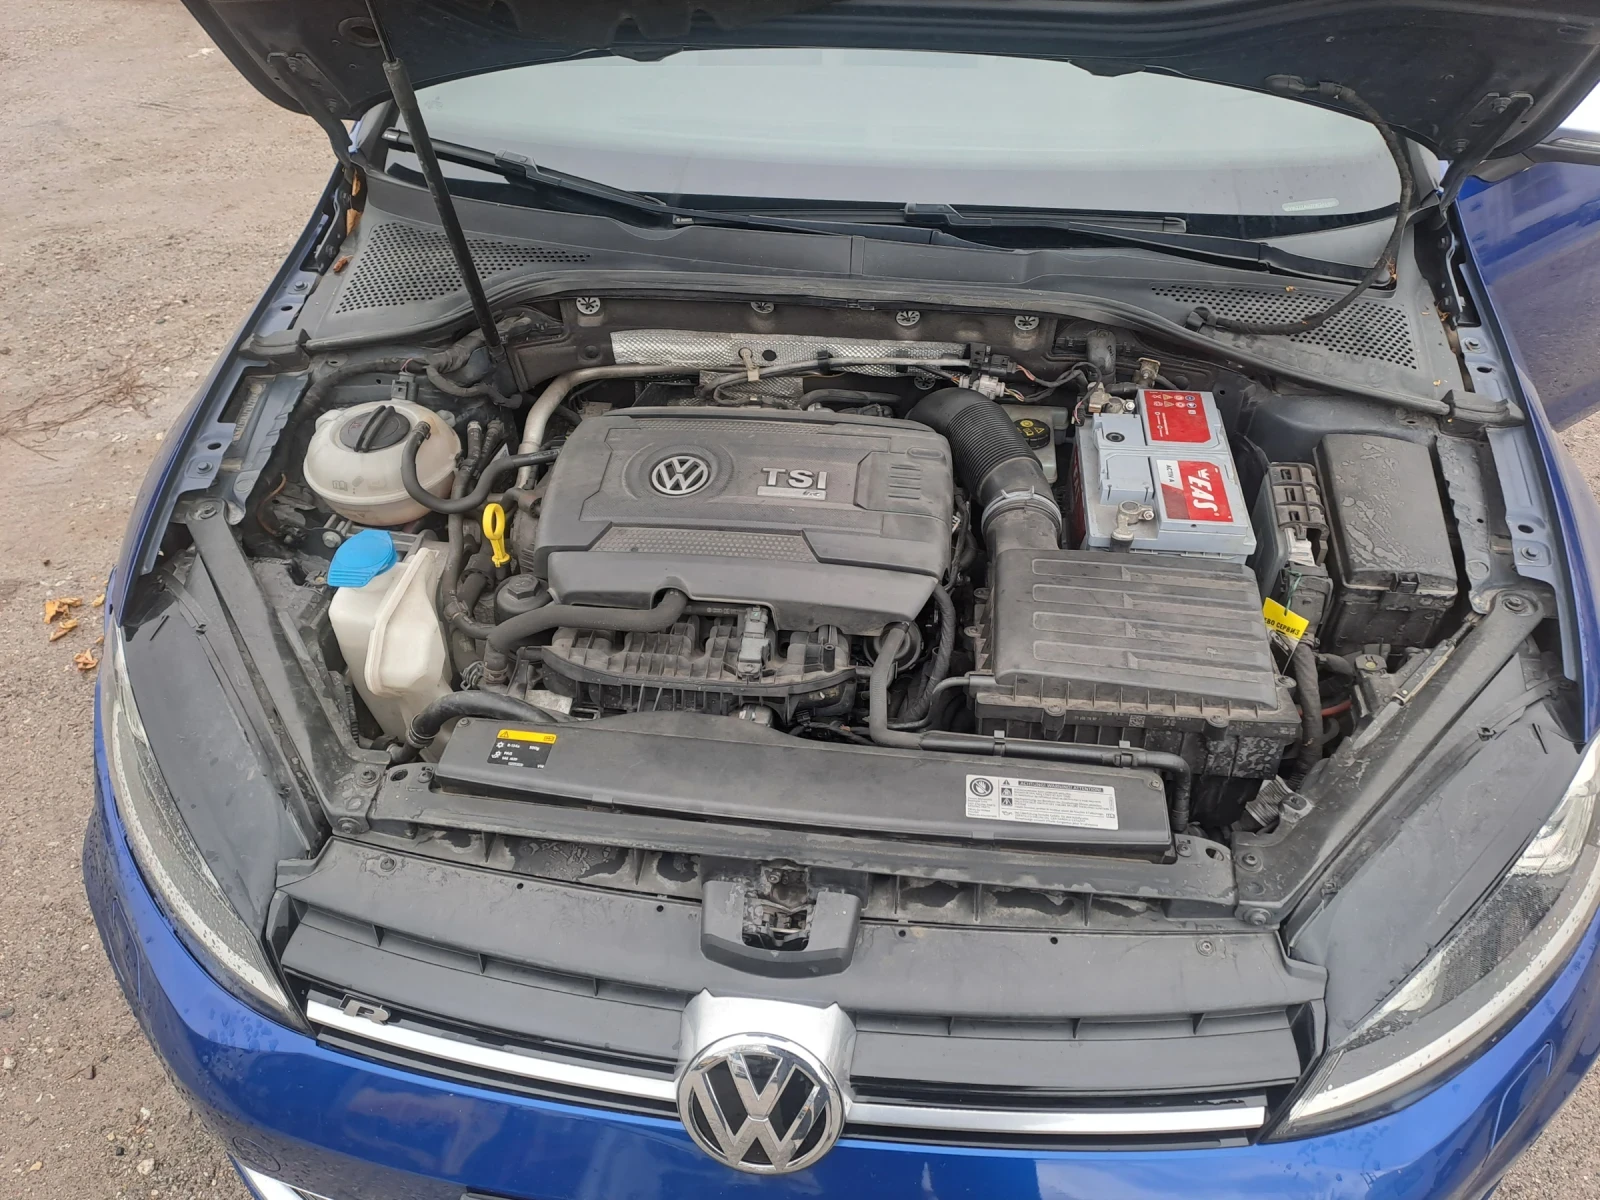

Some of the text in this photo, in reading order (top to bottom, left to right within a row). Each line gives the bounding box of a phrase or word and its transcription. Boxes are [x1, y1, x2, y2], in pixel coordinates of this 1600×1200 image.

[762, 467, 828, 489] TSI
[1276, 622, 1301, 635] СЕРВИЗ
[343, 1000, 389, 1026] R
